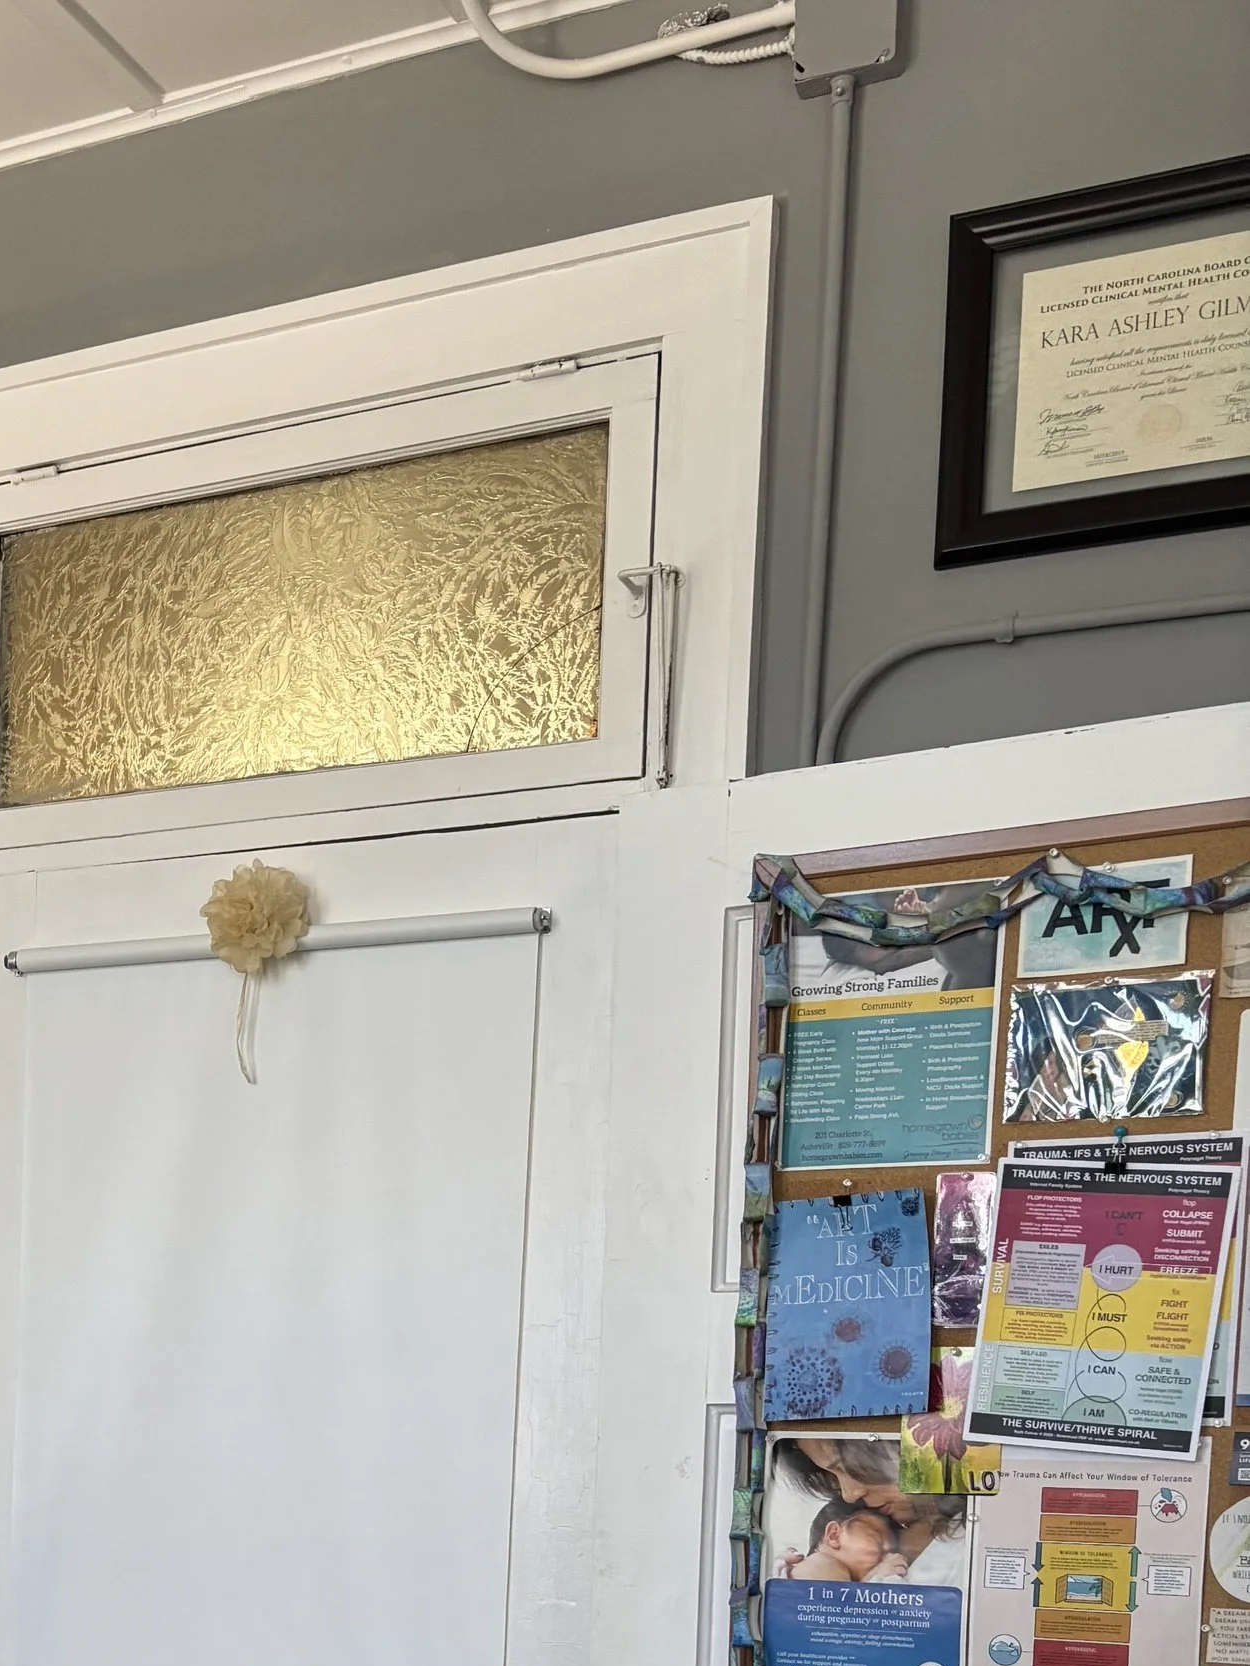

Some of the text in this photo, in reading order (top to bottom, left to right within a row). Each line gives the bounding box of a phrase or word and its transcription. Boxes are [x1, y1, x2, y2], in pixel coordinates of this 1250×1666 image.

[1083, 257, 1241, 294] THE NORTH CAROLINA BOARD
[1041, 269, 1250, 313] LICENSED CLINICAL MENTAL HEALTH CO
[1041, 322, 1099, 348] KARA
[1108, 306, 1190, 336] ASHLEY
[1067, 366, 1104, 378] LICENSED
[1106, 359, 1143, 371] CLINICAL
[1147, 354, 1179, 364] MENTAL
[1183, 347, 1215, 358] HEALTH
[792, 976, 938, 997] Growing Strong Families
[861, 1001, 913, 1011] Community
[939, 995, 974, 1006] Support
[798, 1007, 826, 1016] Classes
[1022, 1150, 1071, 1159] TRAUMA:
[1074, 1149, 1091, 1158] IFS
[1094, 1148, 1101, 1157] &
[1129, 1145, 1184, 1156] NERVOUS
[1187, 1143, 1233, 1153] SYSTEM
[1012, 1169, 1222, 1186] TRAUMA: IFS & THE NERVOUS SYSTEM
[1162, 1210, 1213, 1219] COLLAPSE
[1166, 1229, 1203, 1238] SUBMIT
[992, 1238, 1009, 1293] SURVIVAL
[1099, 1265, 1134, 1275] I HURT
[1161, 1300, 1188, 1308] FIGHT
[1098, 1312, 1127, 1322] MUST
[1156, 1313, 1189, 1321] FLIGHT
[1088, 1365, 1116, 1375] I CAN
[1148, 1367, 1172, 1375] SAFE
[977, 1344, 994, 1410] RESILIENCE
[1135, 1375, 1191, 1385] CONNECTED
[1083, 1408, 1105, 1417] I AM
[1129, 1408, 1188, 1419] CO-REGULATION
[1001, 1417, 1157, 1440] THE SURVIVE/THRIVE SPIRAL
[1013, 1471, 1041, 1479] Trauma
[1060, 1472, 1084, 1480] Affect
[1106, 1473, 1138, 1481] Window
[1140, 1474, 1149, 1482] of
[1152, 1474, 1193, 1483] Tolerance
[808, 1587, 924, 1606] 1 in 7 Mothers
[797, 1604, 841, 1613] experience
[843, 1606, 889, 1616] depression
[899, 1608, 931, 1618] anxiety
[797, 1613, 825, 1623] during
[827, 1616, 870, 1626] pregnancy
[881, 1619, 930, 1628] postpartum
